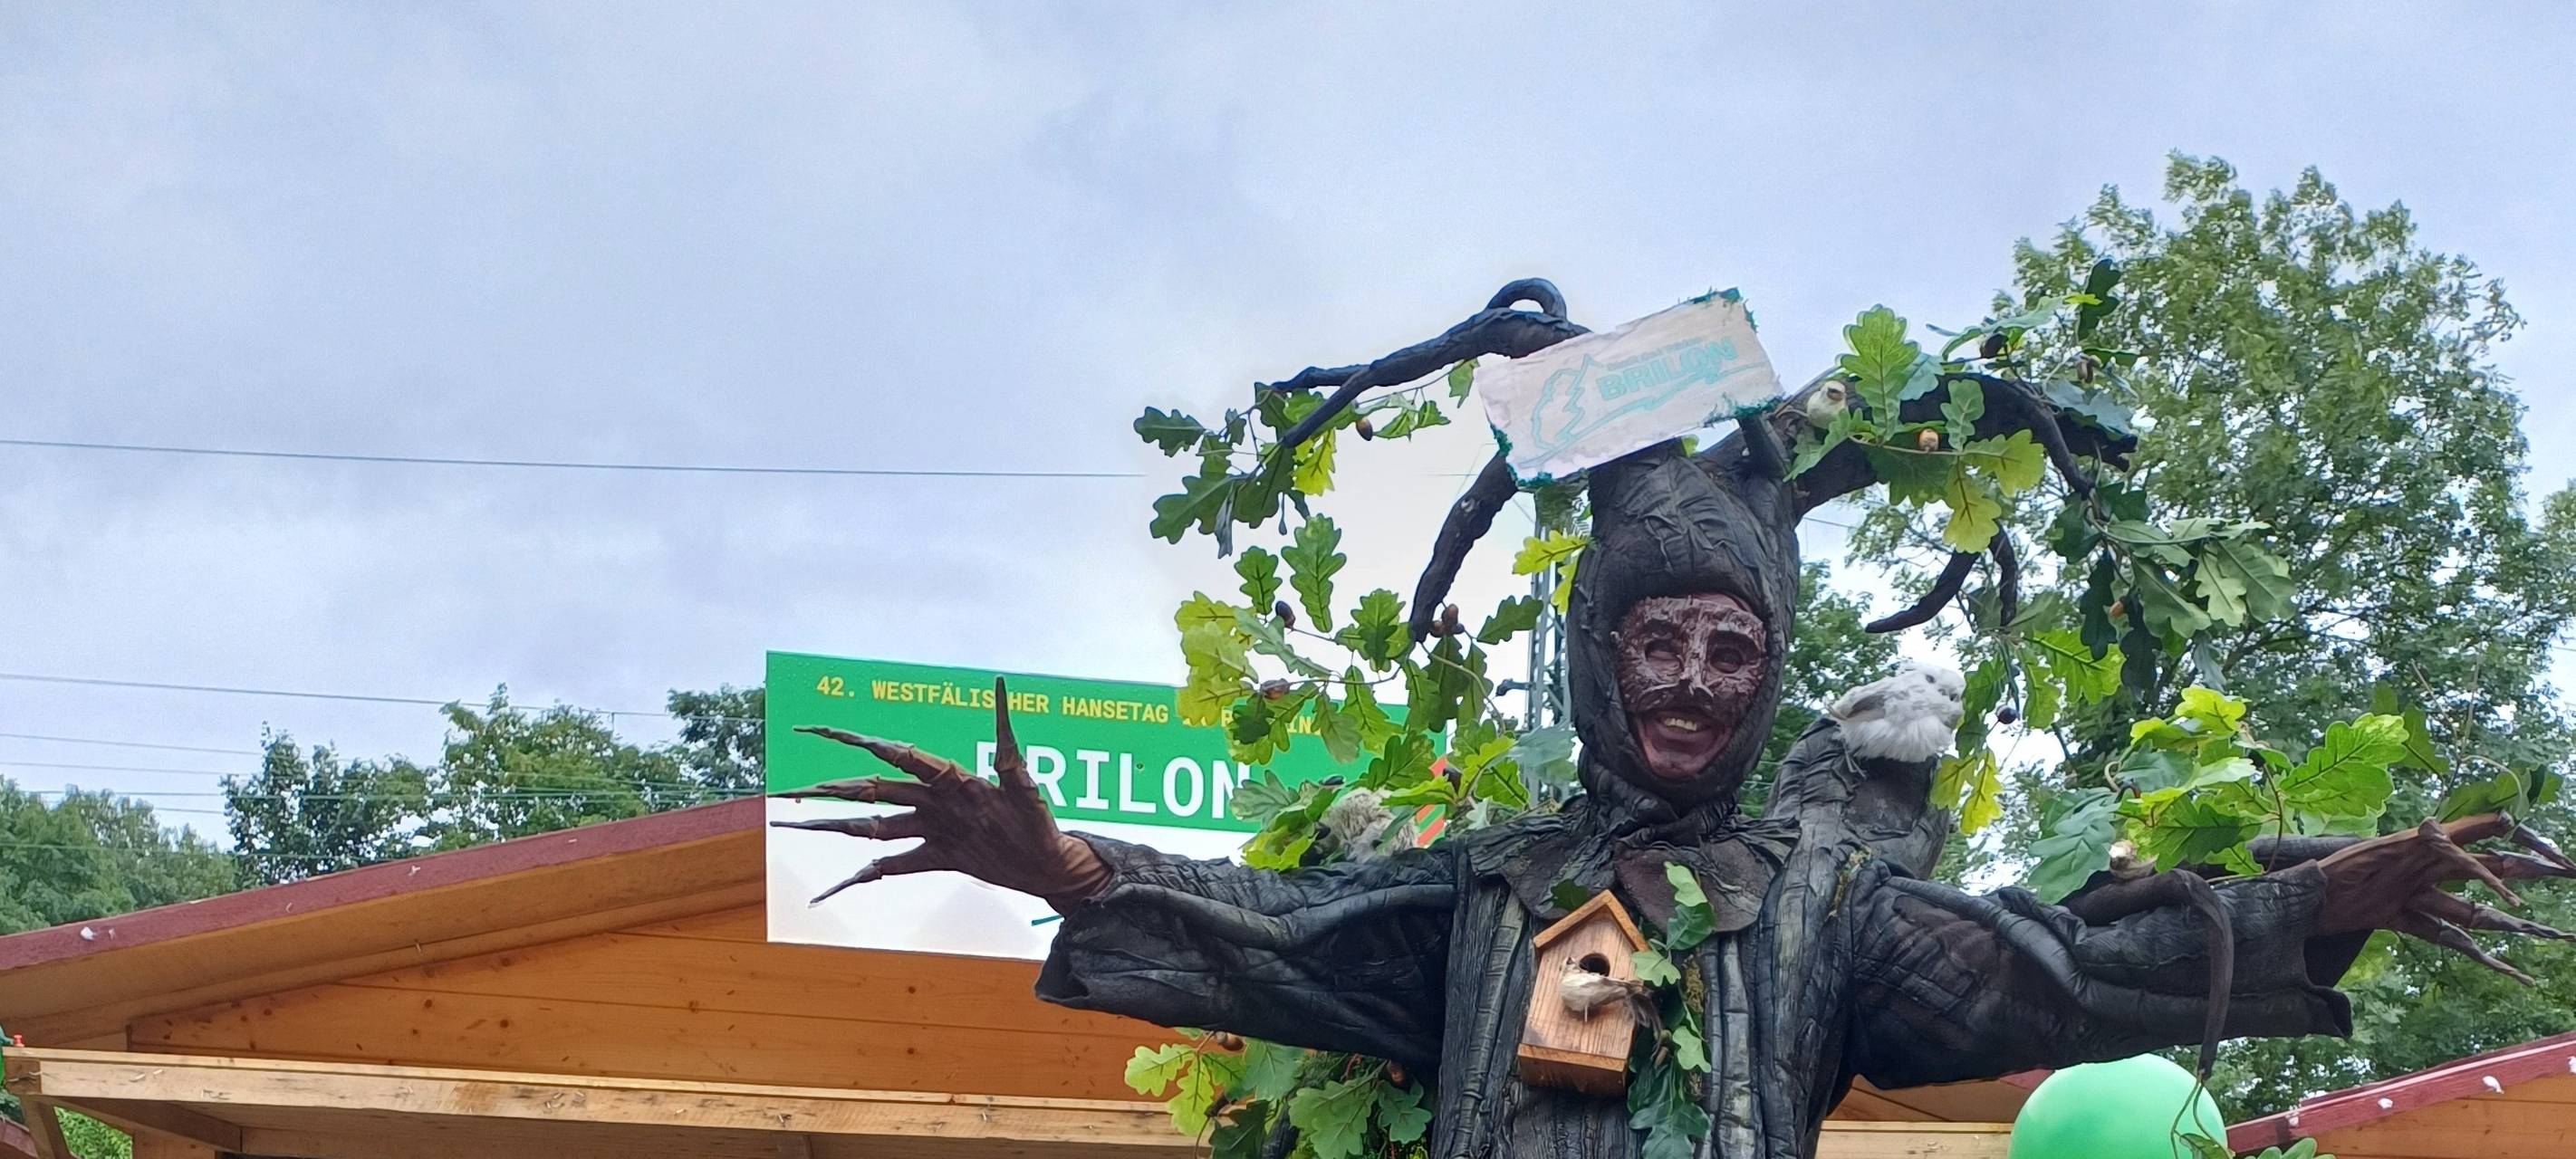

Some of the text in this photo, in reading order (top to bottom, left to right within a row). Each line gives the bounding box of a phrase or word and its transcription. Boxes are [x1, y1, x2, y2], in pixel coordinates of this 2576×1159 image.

[1596, 337, 1740, 401] BRILON
[816, 675, 855, 698] 42.
[870, 680, 1050, 714] WESTFÄLISHER
[1062, 695, 1169, 723] HANSETAG
